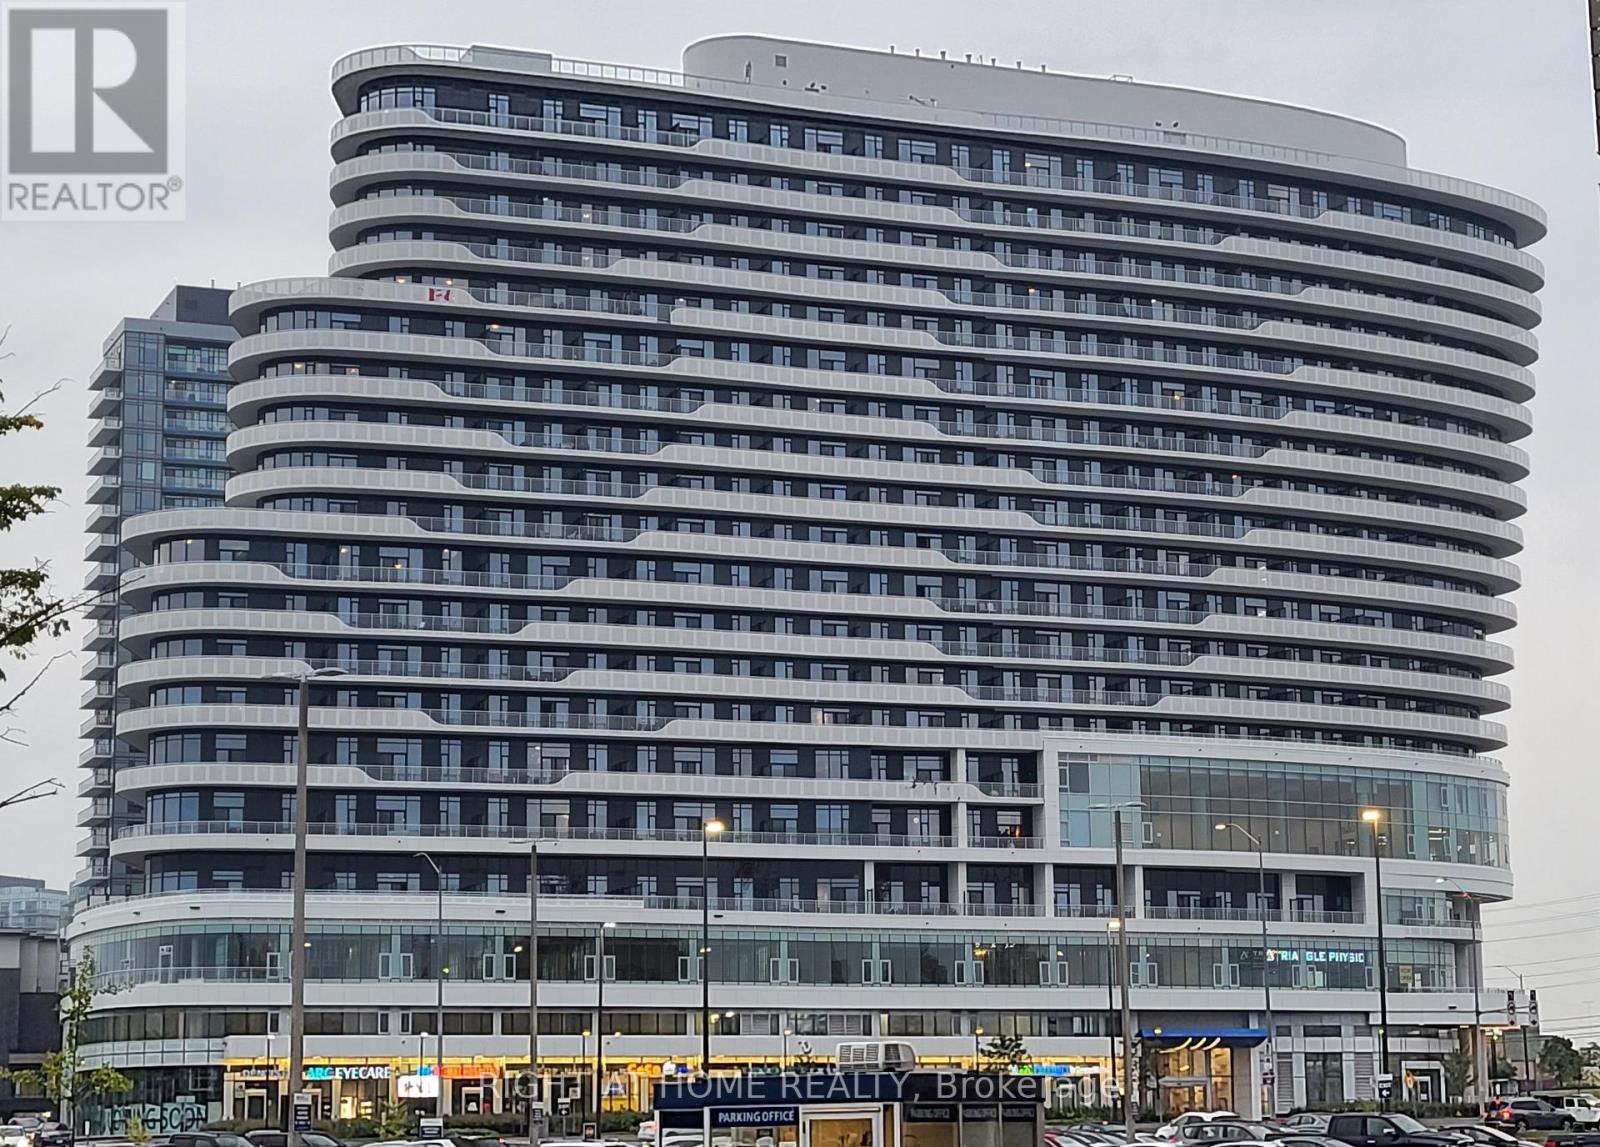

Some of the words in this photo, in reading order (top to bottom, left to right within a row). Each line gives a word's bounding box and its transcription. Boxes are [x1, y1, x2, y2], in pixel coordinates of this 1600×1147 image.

[335, 1066, 392, 1080] EYECARE
[718, 1112, 761, 1123] PARKING
[762, 1110, 795, 1122] OFFICE
